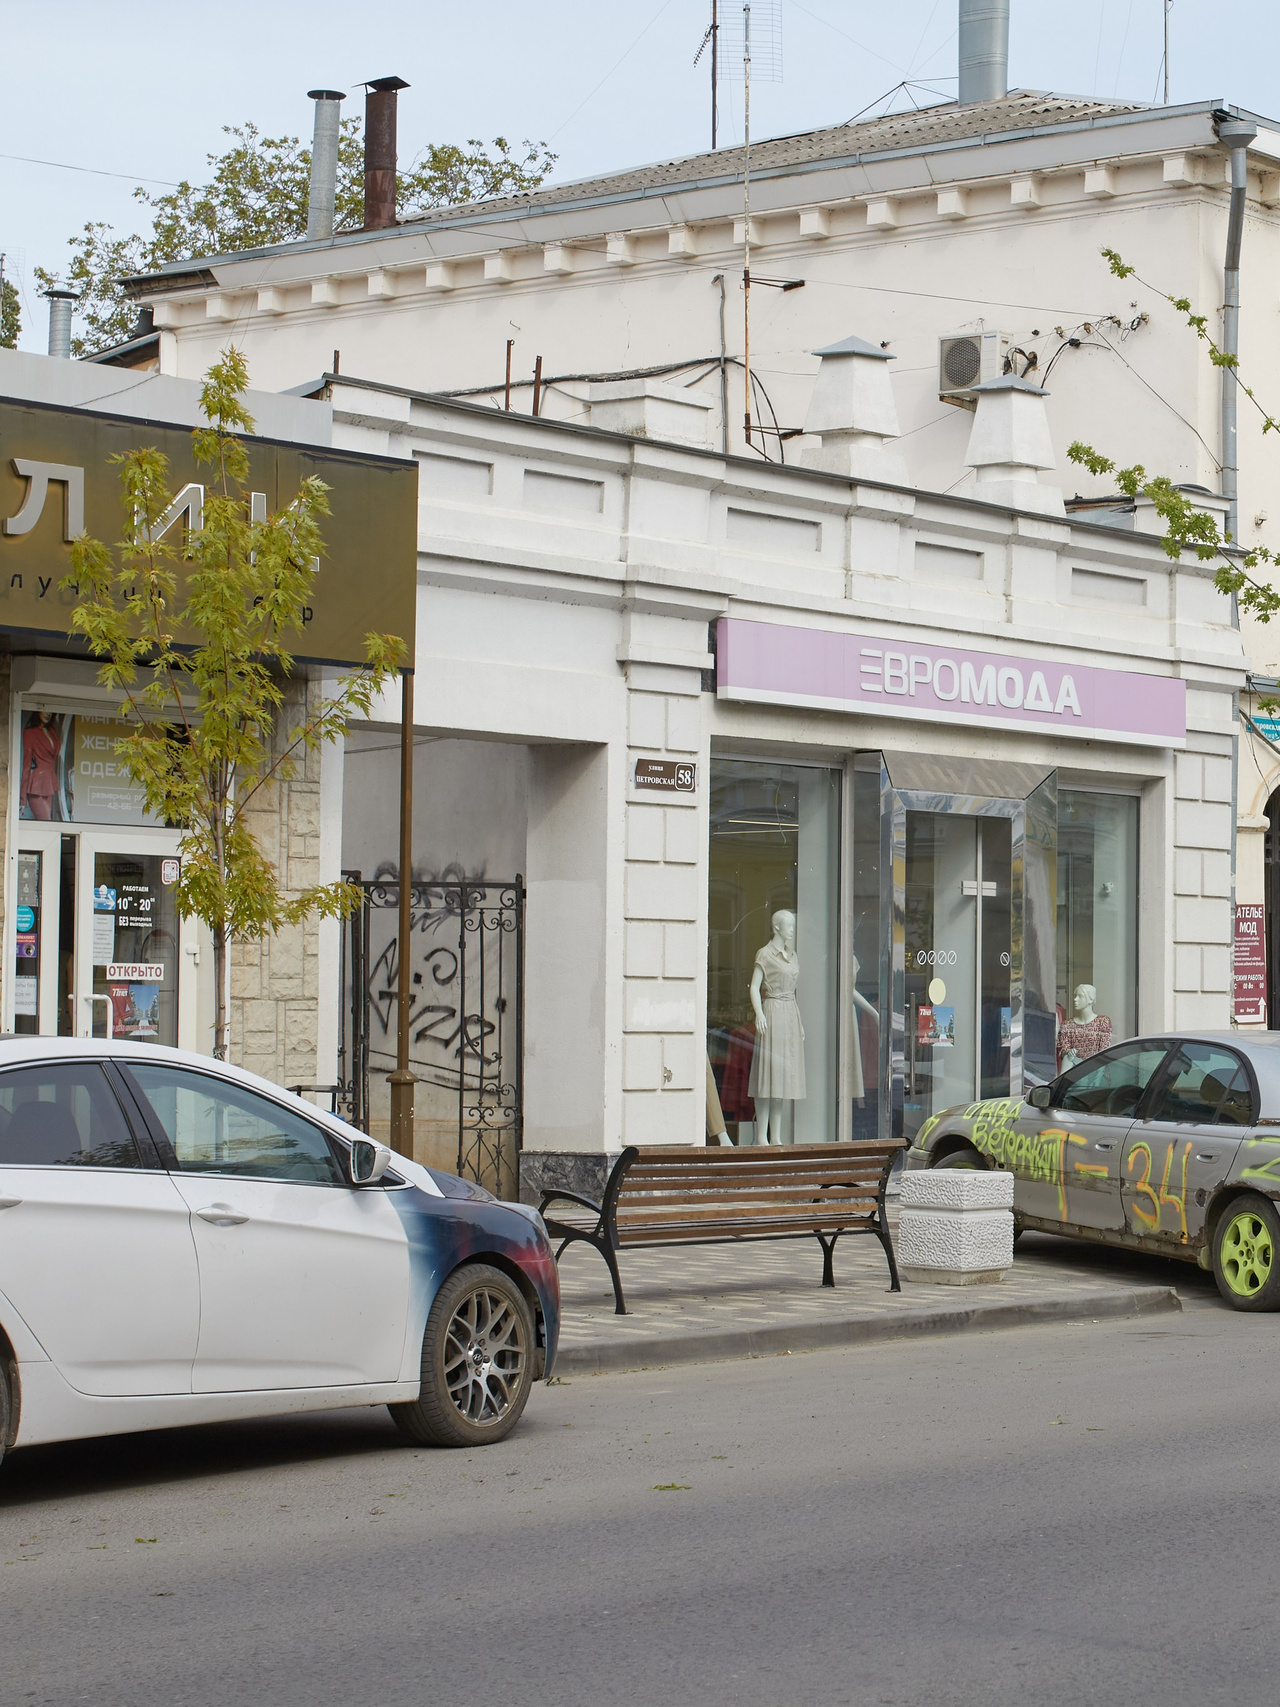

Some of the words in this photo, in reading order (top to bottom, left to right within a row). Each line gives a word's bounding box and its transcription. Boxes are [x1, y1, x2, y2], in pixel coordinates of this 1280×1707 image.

[860, 648, 1082, 716] ЕВРОМОДА
[636, 775, 675, 786] ПЕТРОВСКАЯ
[678, 769, 692, 785] 58
[1236, 906, 1263, 918] АТЕЛЬЕ
[119, 916, 129, 926] БЕЗ
[1239, 921, 1258, 935] МОД
[108, 965, 163, 977] ОТКРЫТО
